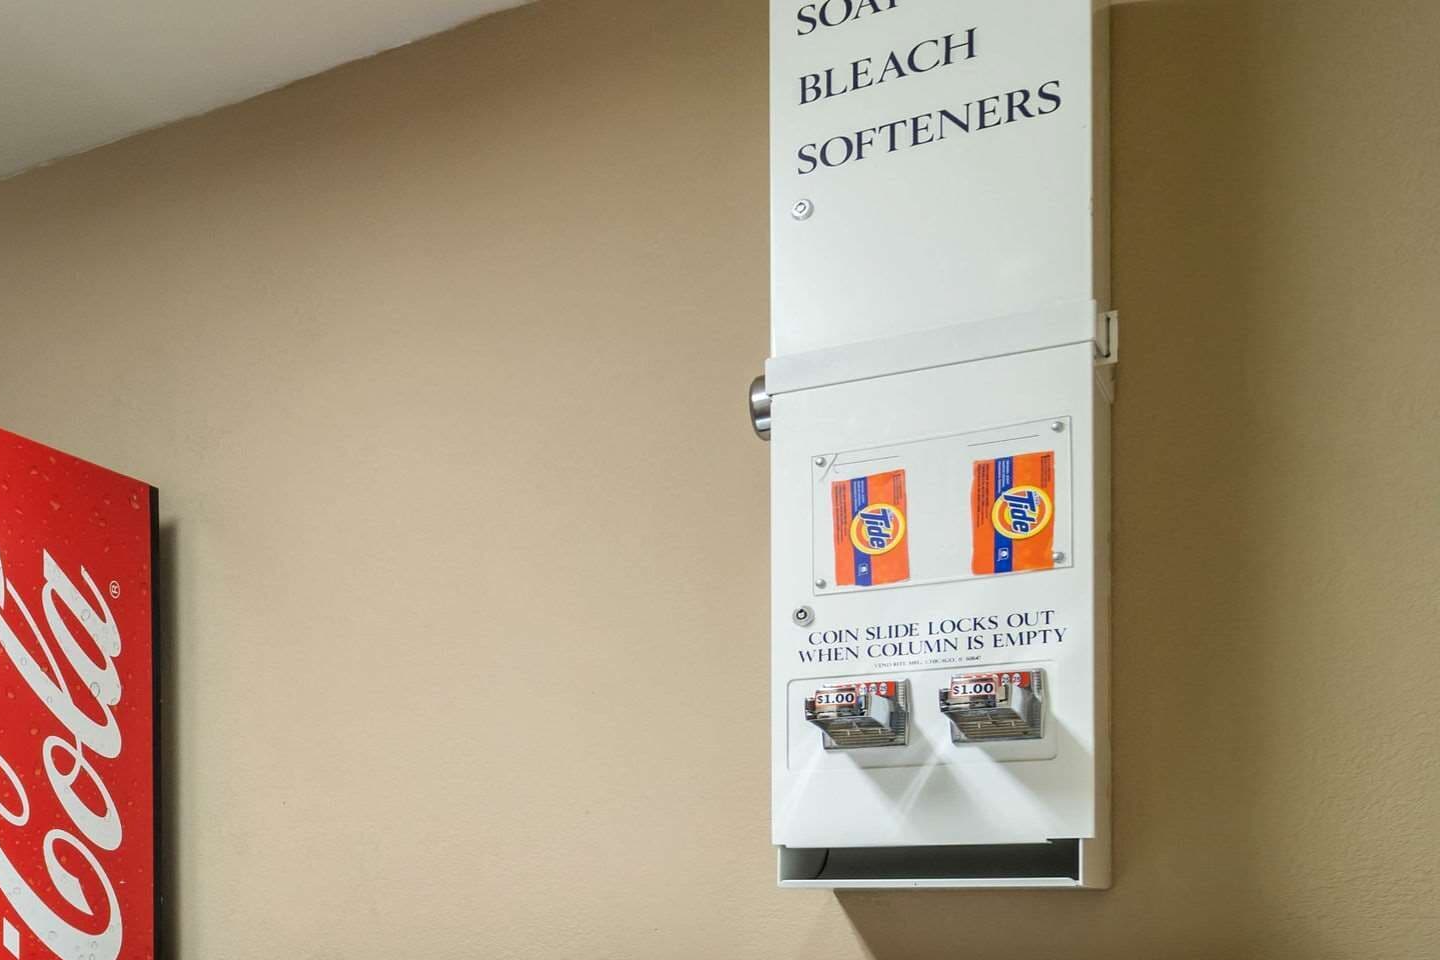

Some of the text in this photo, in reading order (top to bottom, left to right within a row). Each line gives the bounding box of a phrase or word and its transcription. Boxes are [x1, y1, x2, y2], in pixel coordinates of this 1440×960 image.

[796, 0, 897, 36] SOA
[798, 27, 977, 105] BLEACH
[797, 80, 1061, 175] SOFTENERS
[859, 507, 892, 549] Tide
[1003, 490, 1037, 532] Tide
[799, 627, 1067, 663] WHEN COLUMN IS EMPTY
[809, 610, 1055, 646] COIN SLIDE LOCKS OUT
[817, 693, 854, 704] $1.00
[953, 684, 993, 695] $1.00
